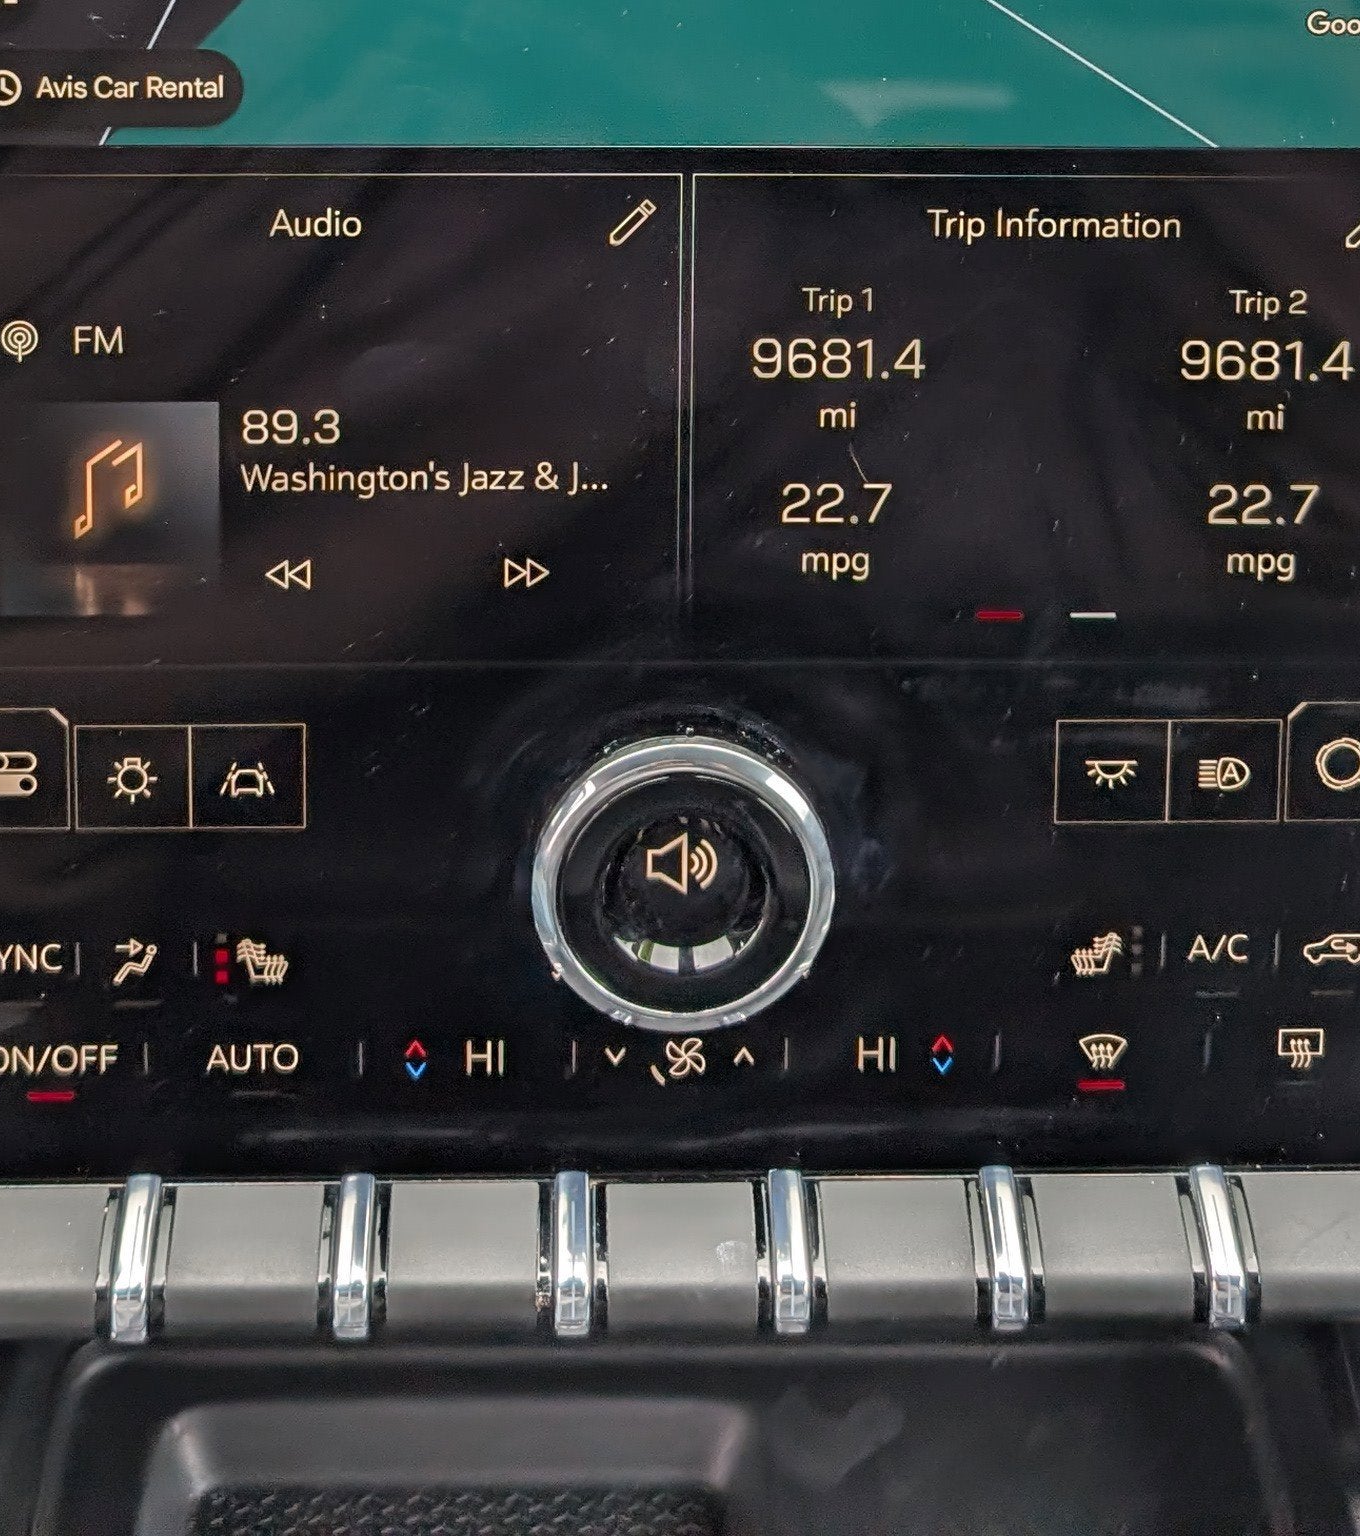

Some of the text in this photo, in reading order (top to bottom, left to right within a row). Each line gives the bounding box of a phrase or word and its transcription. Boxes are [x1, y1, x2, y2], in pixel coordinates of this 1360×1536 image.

[35, 74, 224, 99] Avis Car Rental
[269, 207, 362, 238] Audio
[927, 207, 1181, 246] Trip Information
[801, 287, 873, 319] Trip 1
[1228, 289, 1308, 321] Trip 2
[74, 325, 124, 354] FM
[752, 337, 926, 379] 9681.4
[1181, 339, 1355, 382] 9681.4
[242, 408, 340, 445] 89.3
[819, 401, 857, 428] mi
[1246, 403, 1285, 430] mi
[240, 460, 608, 500] Washington's Jazz & J...
[781, 483, 893, 524] 22.7
[1207, 484, 1320, 525] 22.7
[801, 552, 870, 581] mpg
[1226, 553, 1295, 582] mpg
[1187, 933, 1248, 962] A/C
[206, 1043, 299, 1072] AUTO
[465, 1039, 504, 1075] HI
[857, 1036, 896, 1072] HI
